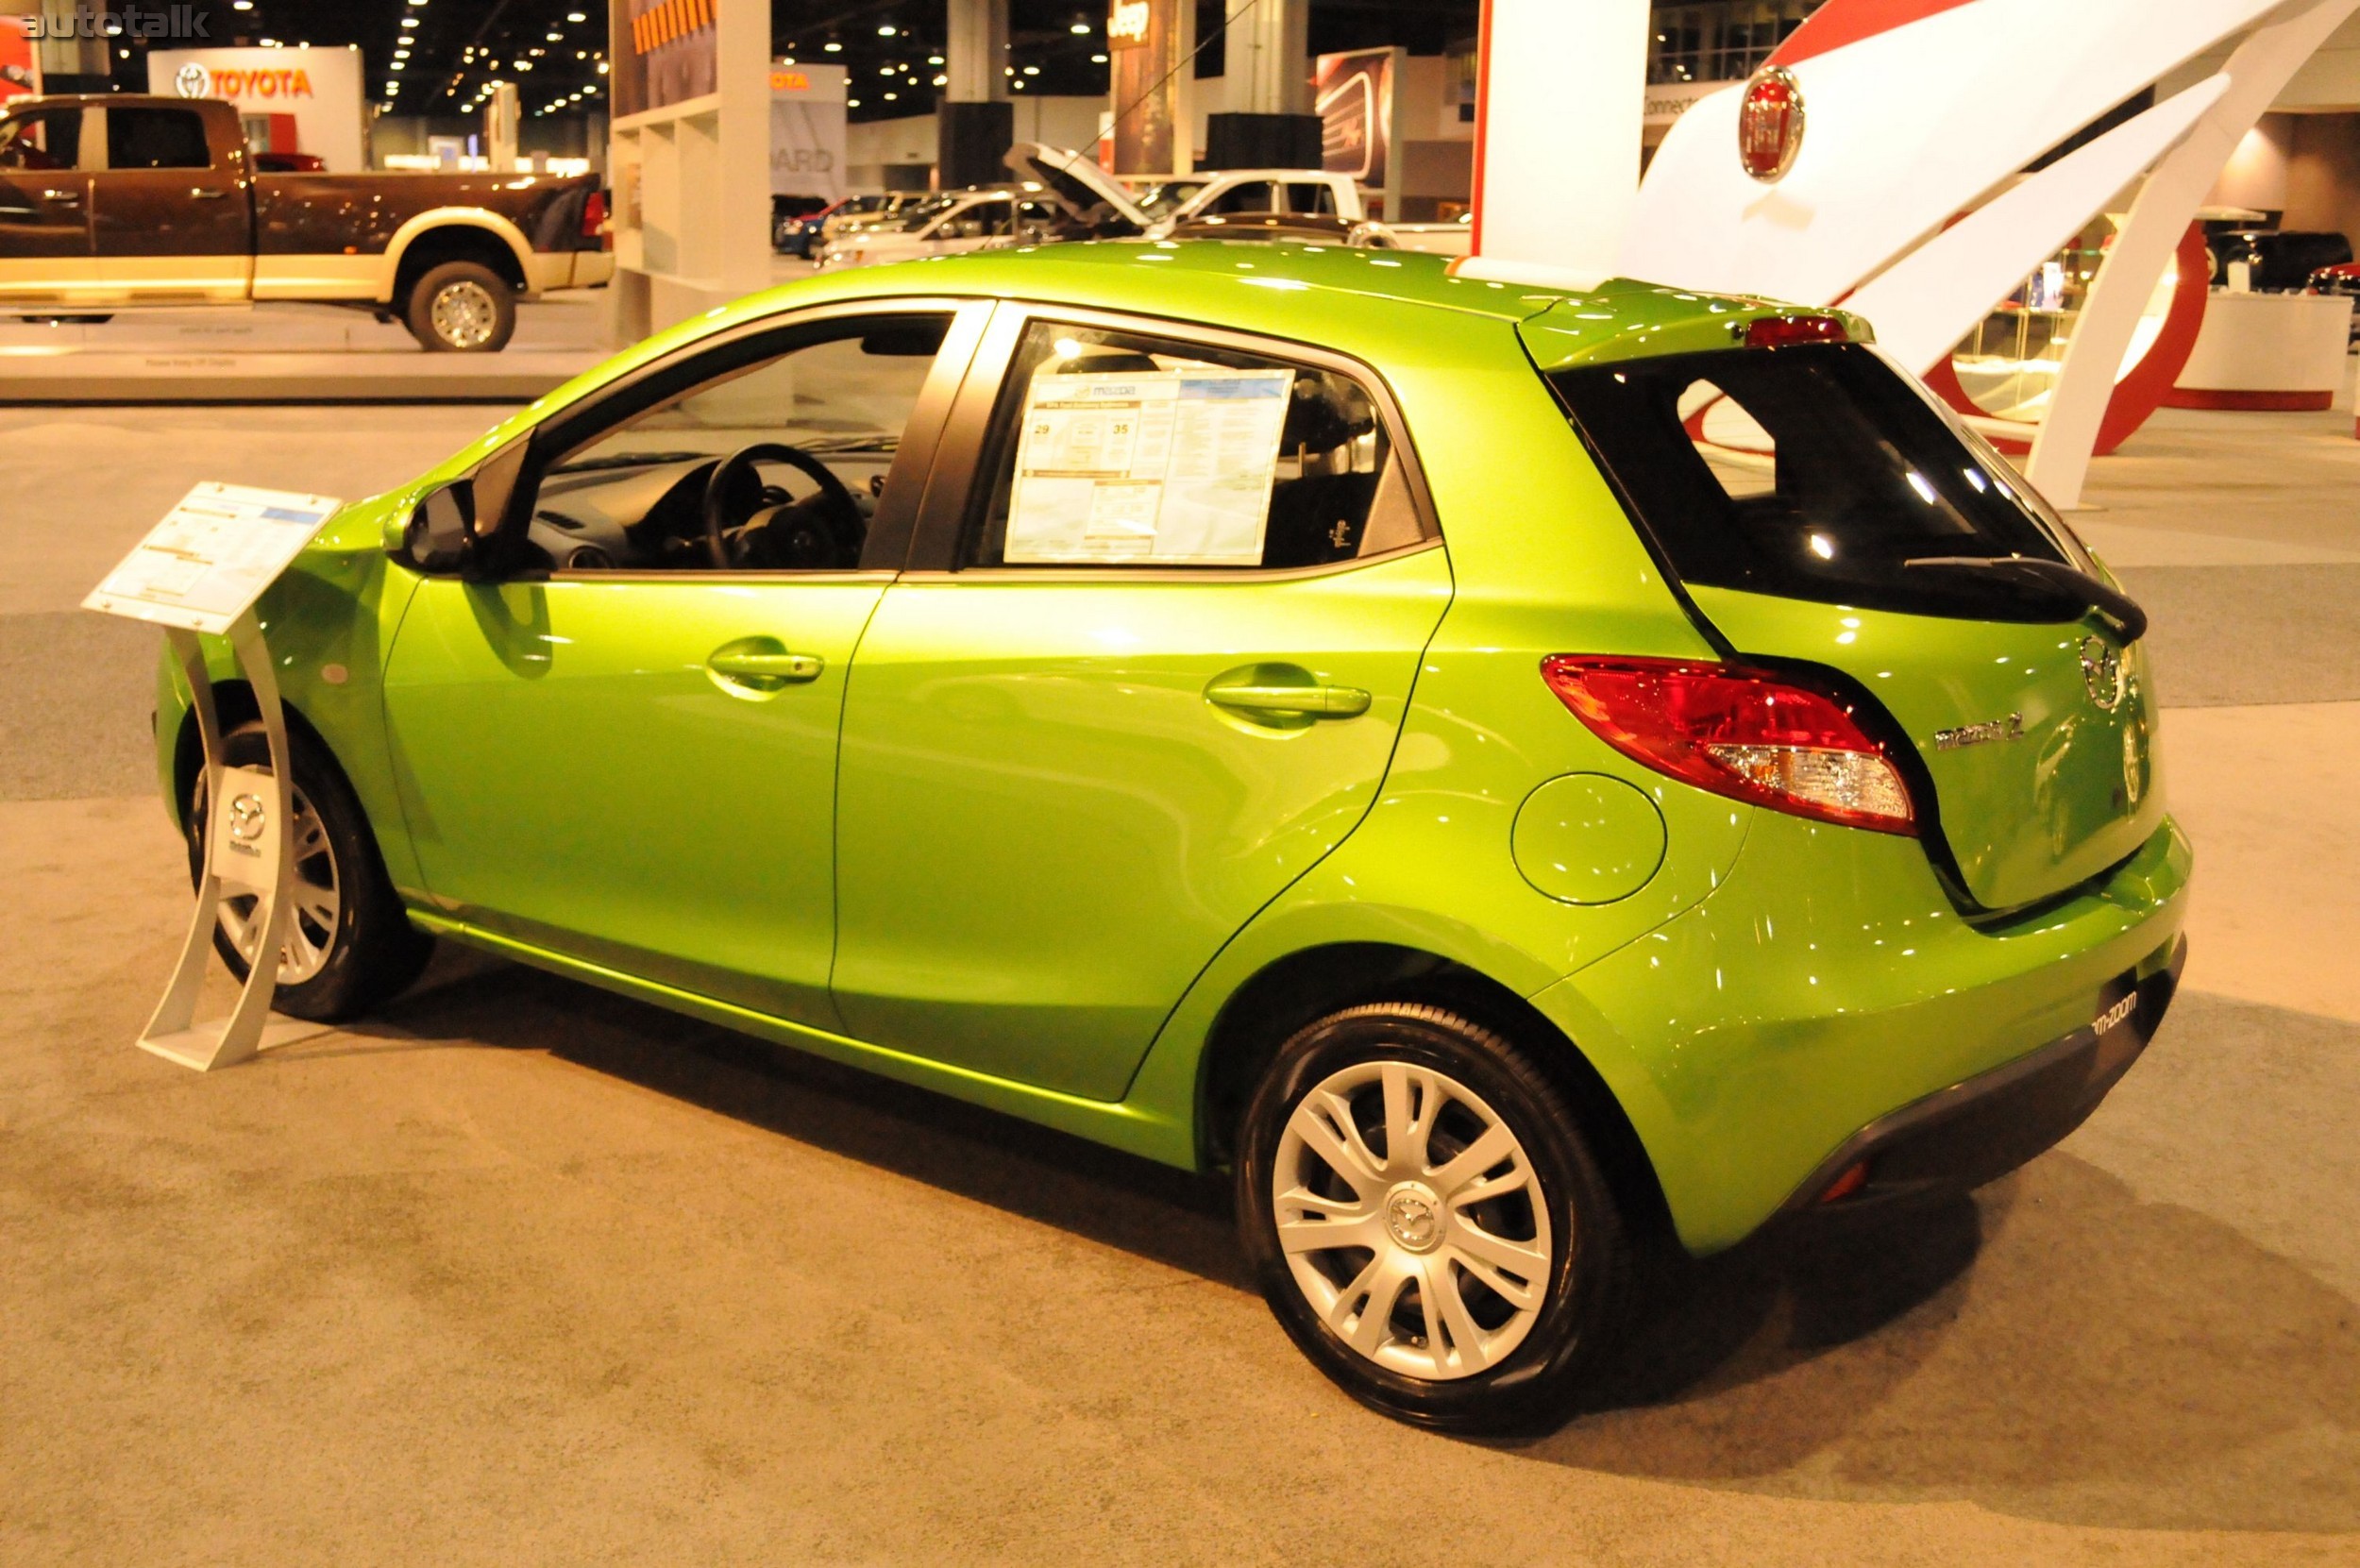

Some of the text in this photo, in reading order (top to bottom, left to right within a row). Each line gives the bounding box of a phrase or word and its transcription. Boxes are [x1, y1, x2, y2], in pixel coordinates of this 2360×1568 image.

[1107, 0, 1150, 42] Jeep
[210, 69, 312, 98] TOYOTA
[769, 148, 834, 172] ARD
[1035, 424, 1050, 434] 29
[1113, 424, 1128, 434] 35
[2092, 990, 2137, 1036] m-zoom
